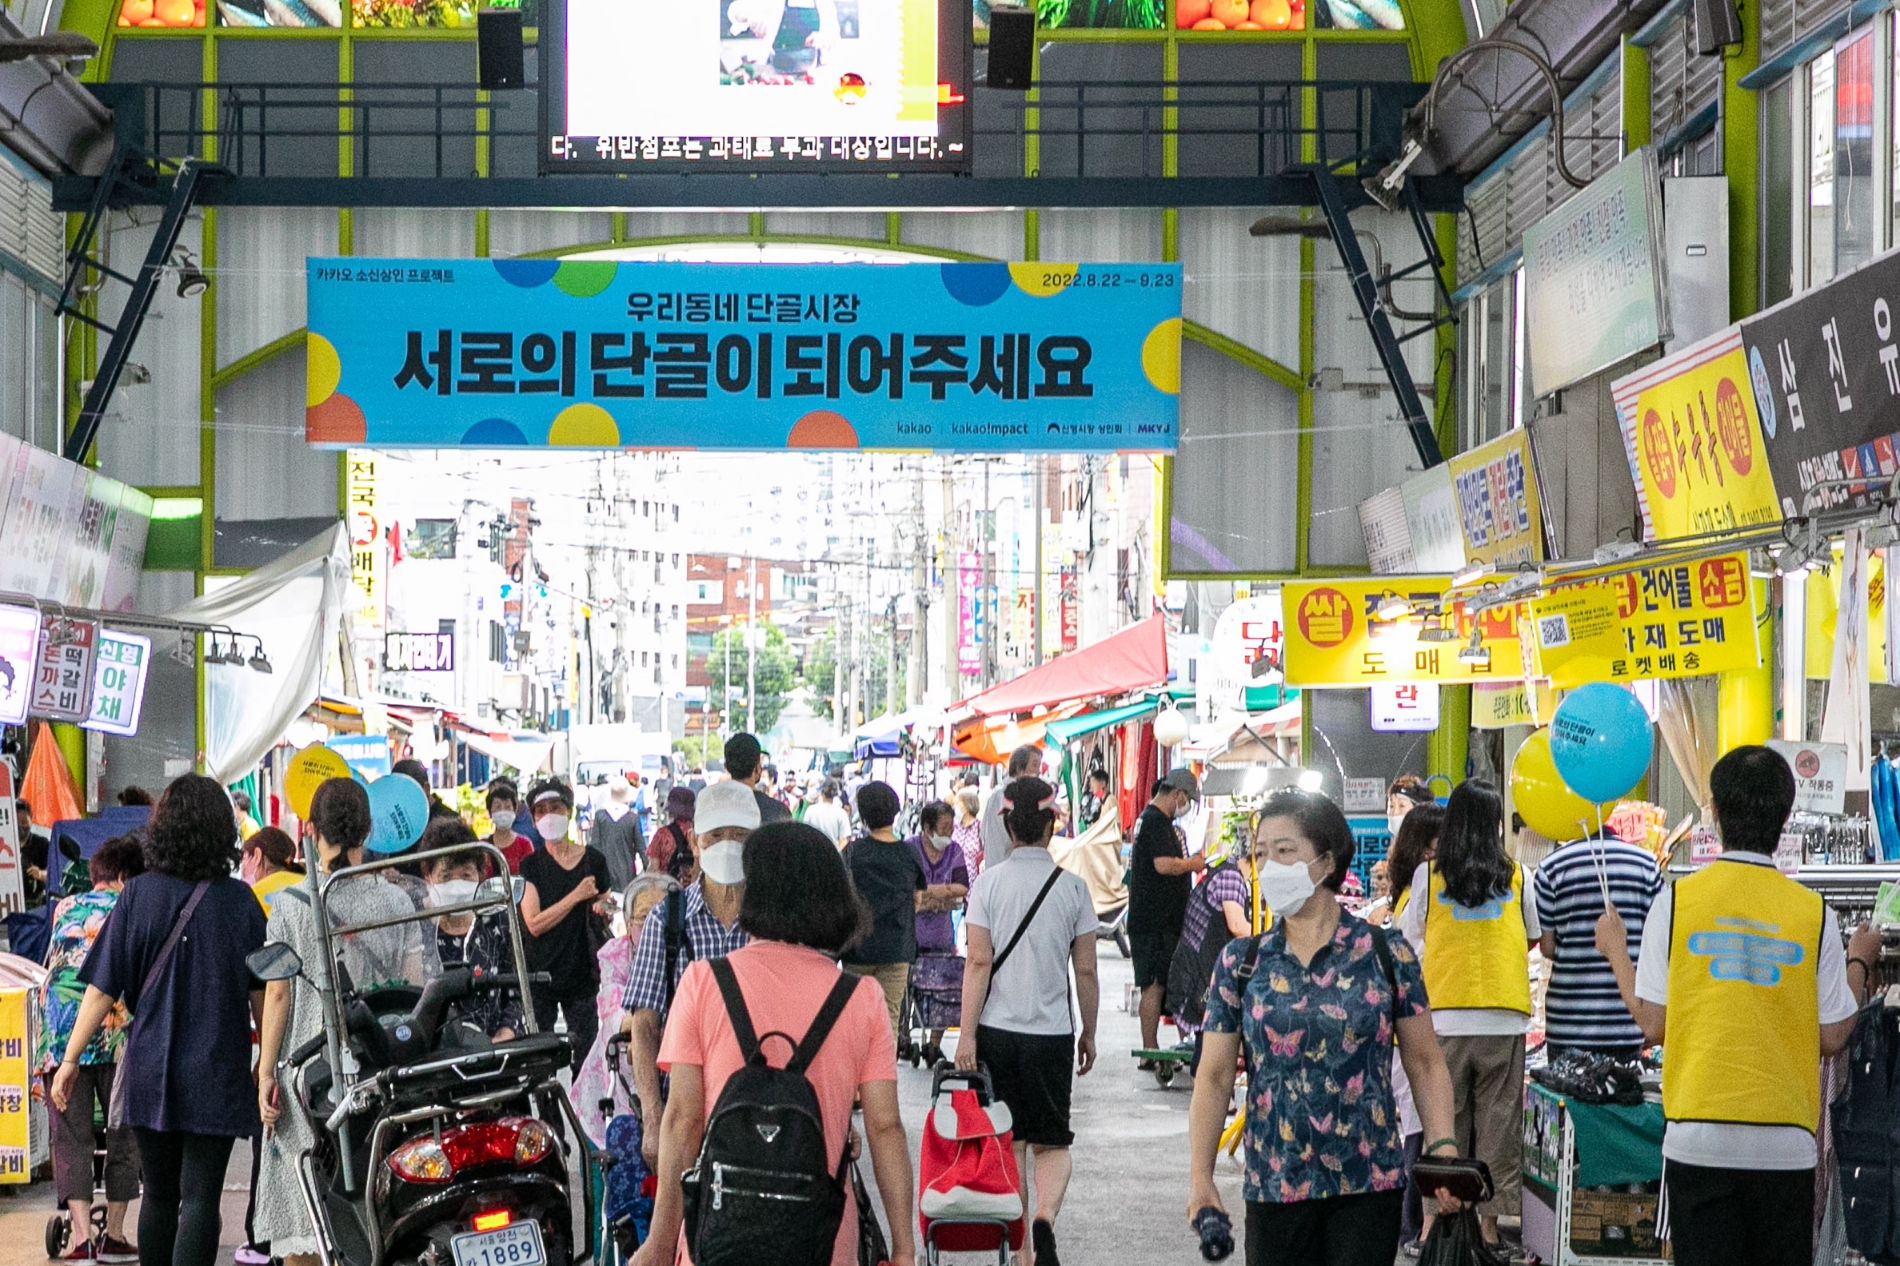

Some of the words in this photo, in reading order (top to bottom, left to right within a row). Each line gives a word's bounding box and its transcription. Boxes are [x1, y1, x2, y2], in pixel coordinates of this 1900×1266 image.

[596, 136, 703, 159] 위반점포는
[708, 136, 774, 159] 과태료
[780, 136, 824, 159] 부과
[317, 267, 353, 282] 카카오
[355, 267, 405, 283] 소신상인
[408, 268, 455, 284] 프로젝트
[1043, 273, 1121, 288] 2022.8.22
[1140, 273, 1175, 287] 9.23
[627, 292, 739, 323] 우리동네
[746, 293, 861, 324] 단골시장
[392, 329, 577, 398] 서로의
[590, 331, 773, 399] 단골이
[783, 333, 1094, 400] 되어주세요
[897, 422, 932, 434] kakao
[351, 462, 375, 507] 전국
[1641, 567, 1693, 612] 건어물
[1304, 594, 1348, 642] 쌀
[482, 1241, 532, 1266] 1889
